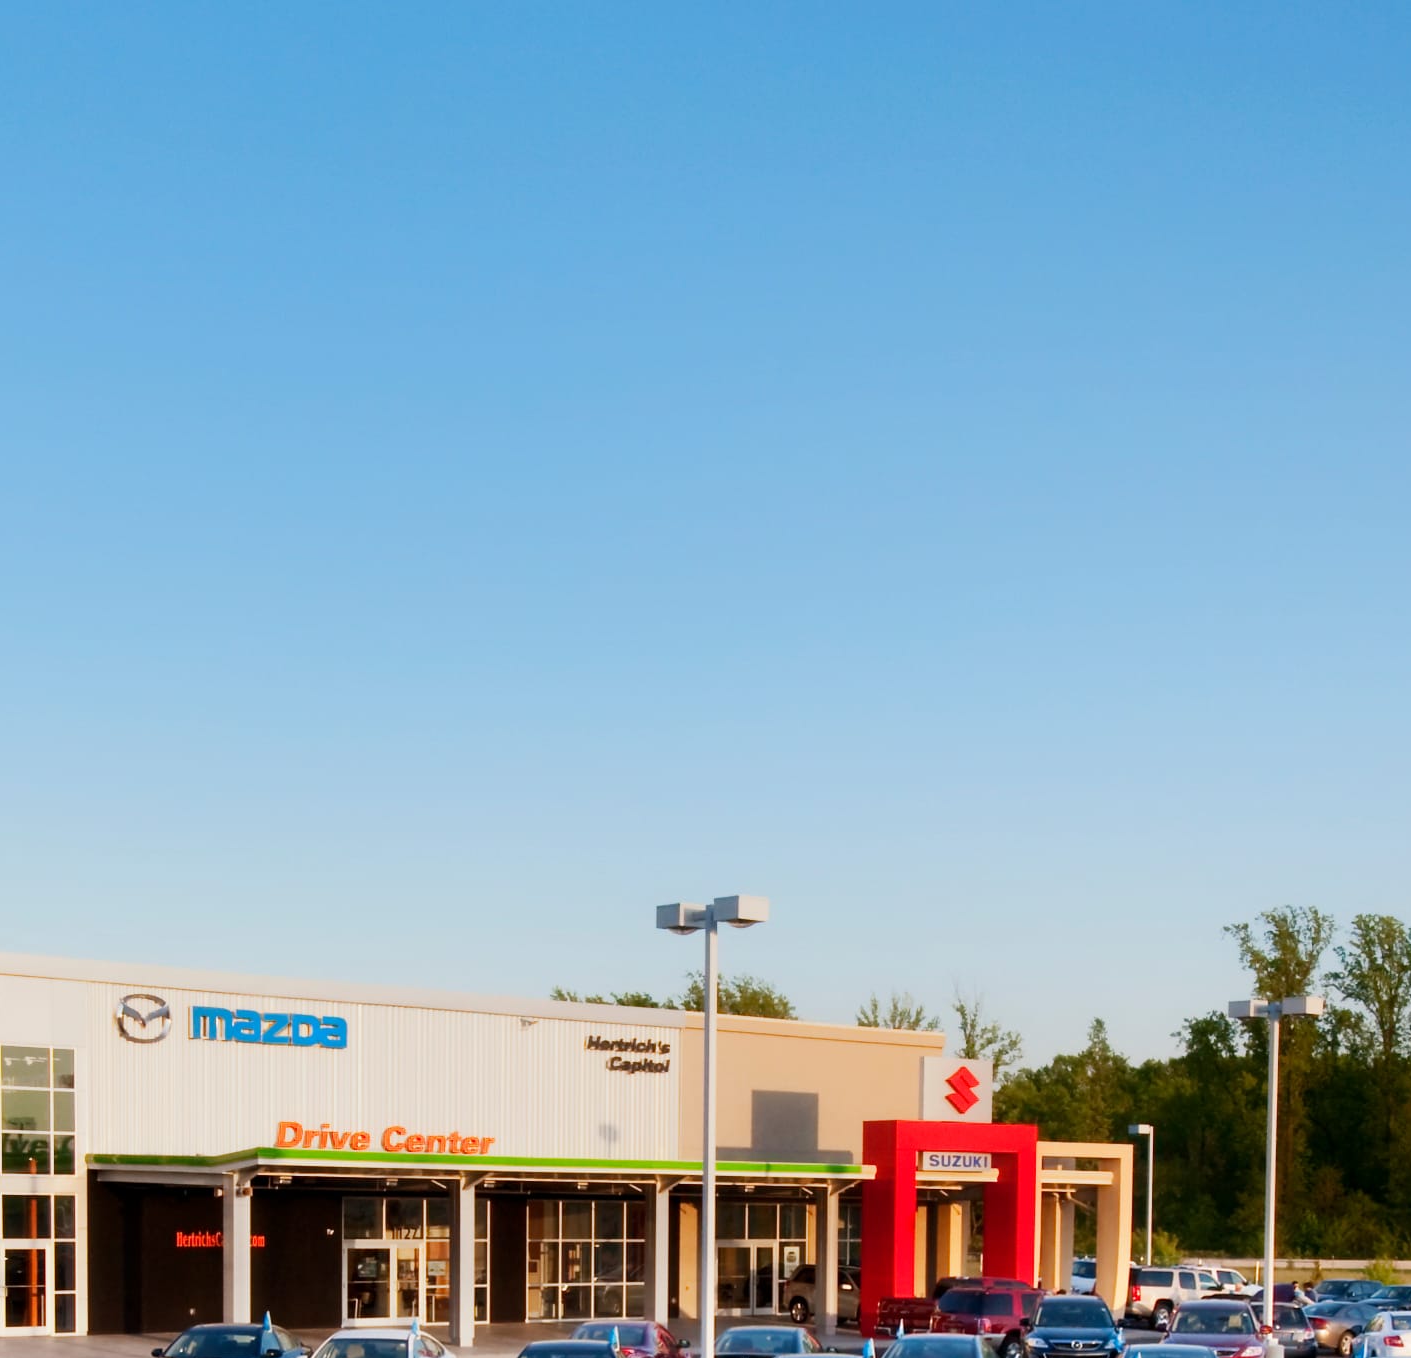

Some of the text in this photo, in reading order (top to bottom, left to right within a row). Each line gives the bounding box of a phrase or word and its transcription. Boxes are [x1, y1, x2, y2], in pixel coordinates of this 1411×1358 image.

[191, 1005, 348, 1049] mazda
[586, 1035, 671, 1054] Hertrich's
[607, 1056, 671, 1074] Capitol
[274, 1121, 495, 1154] Drive Center
[929, 1154, 989, 1168] SUZUKI
